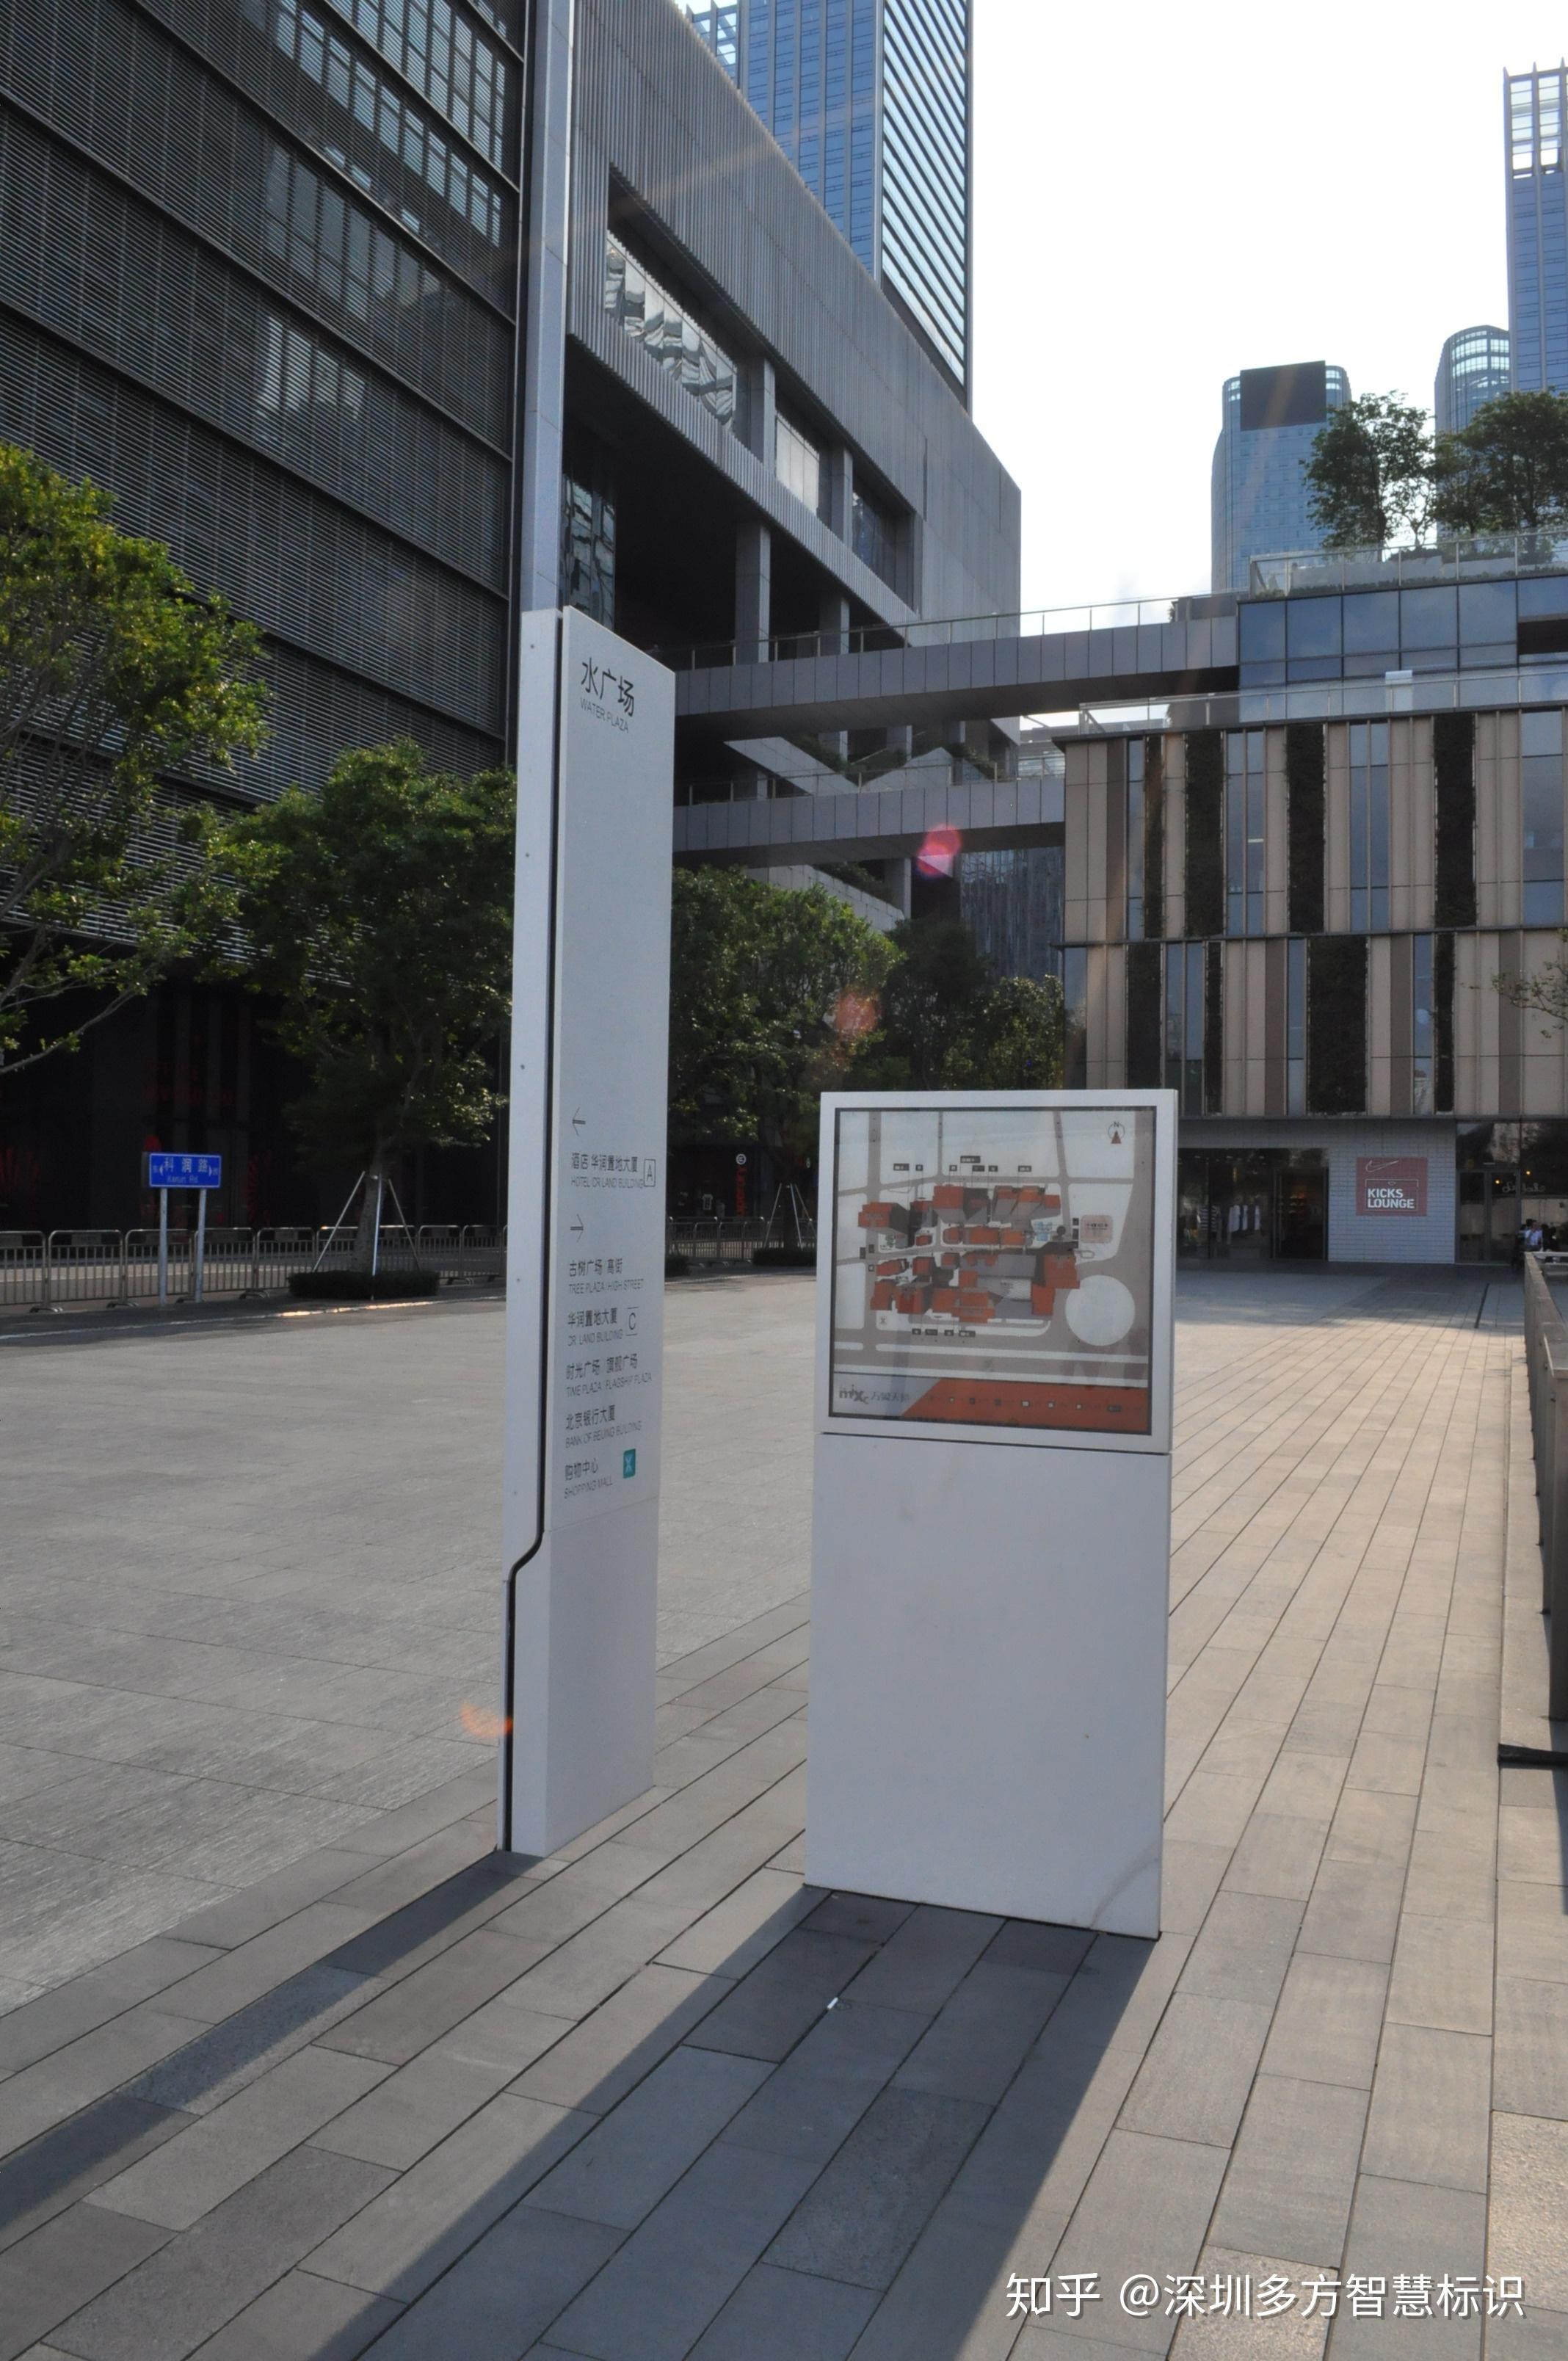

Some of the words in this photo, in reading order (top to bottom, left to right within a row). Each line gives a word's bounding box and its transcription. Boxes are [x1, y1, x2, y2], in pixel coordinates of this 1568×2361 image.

[581, 657, 634, 717] 水广场
[580, 697, 606, 721] WATER
[606, 711, 629, 733] PLAZA
[1368, 1188, 1404, 1198] KICKS
[1368, 1199, 1415, 1208] LOUNGE
[628, 1312, 636, 1330] C
